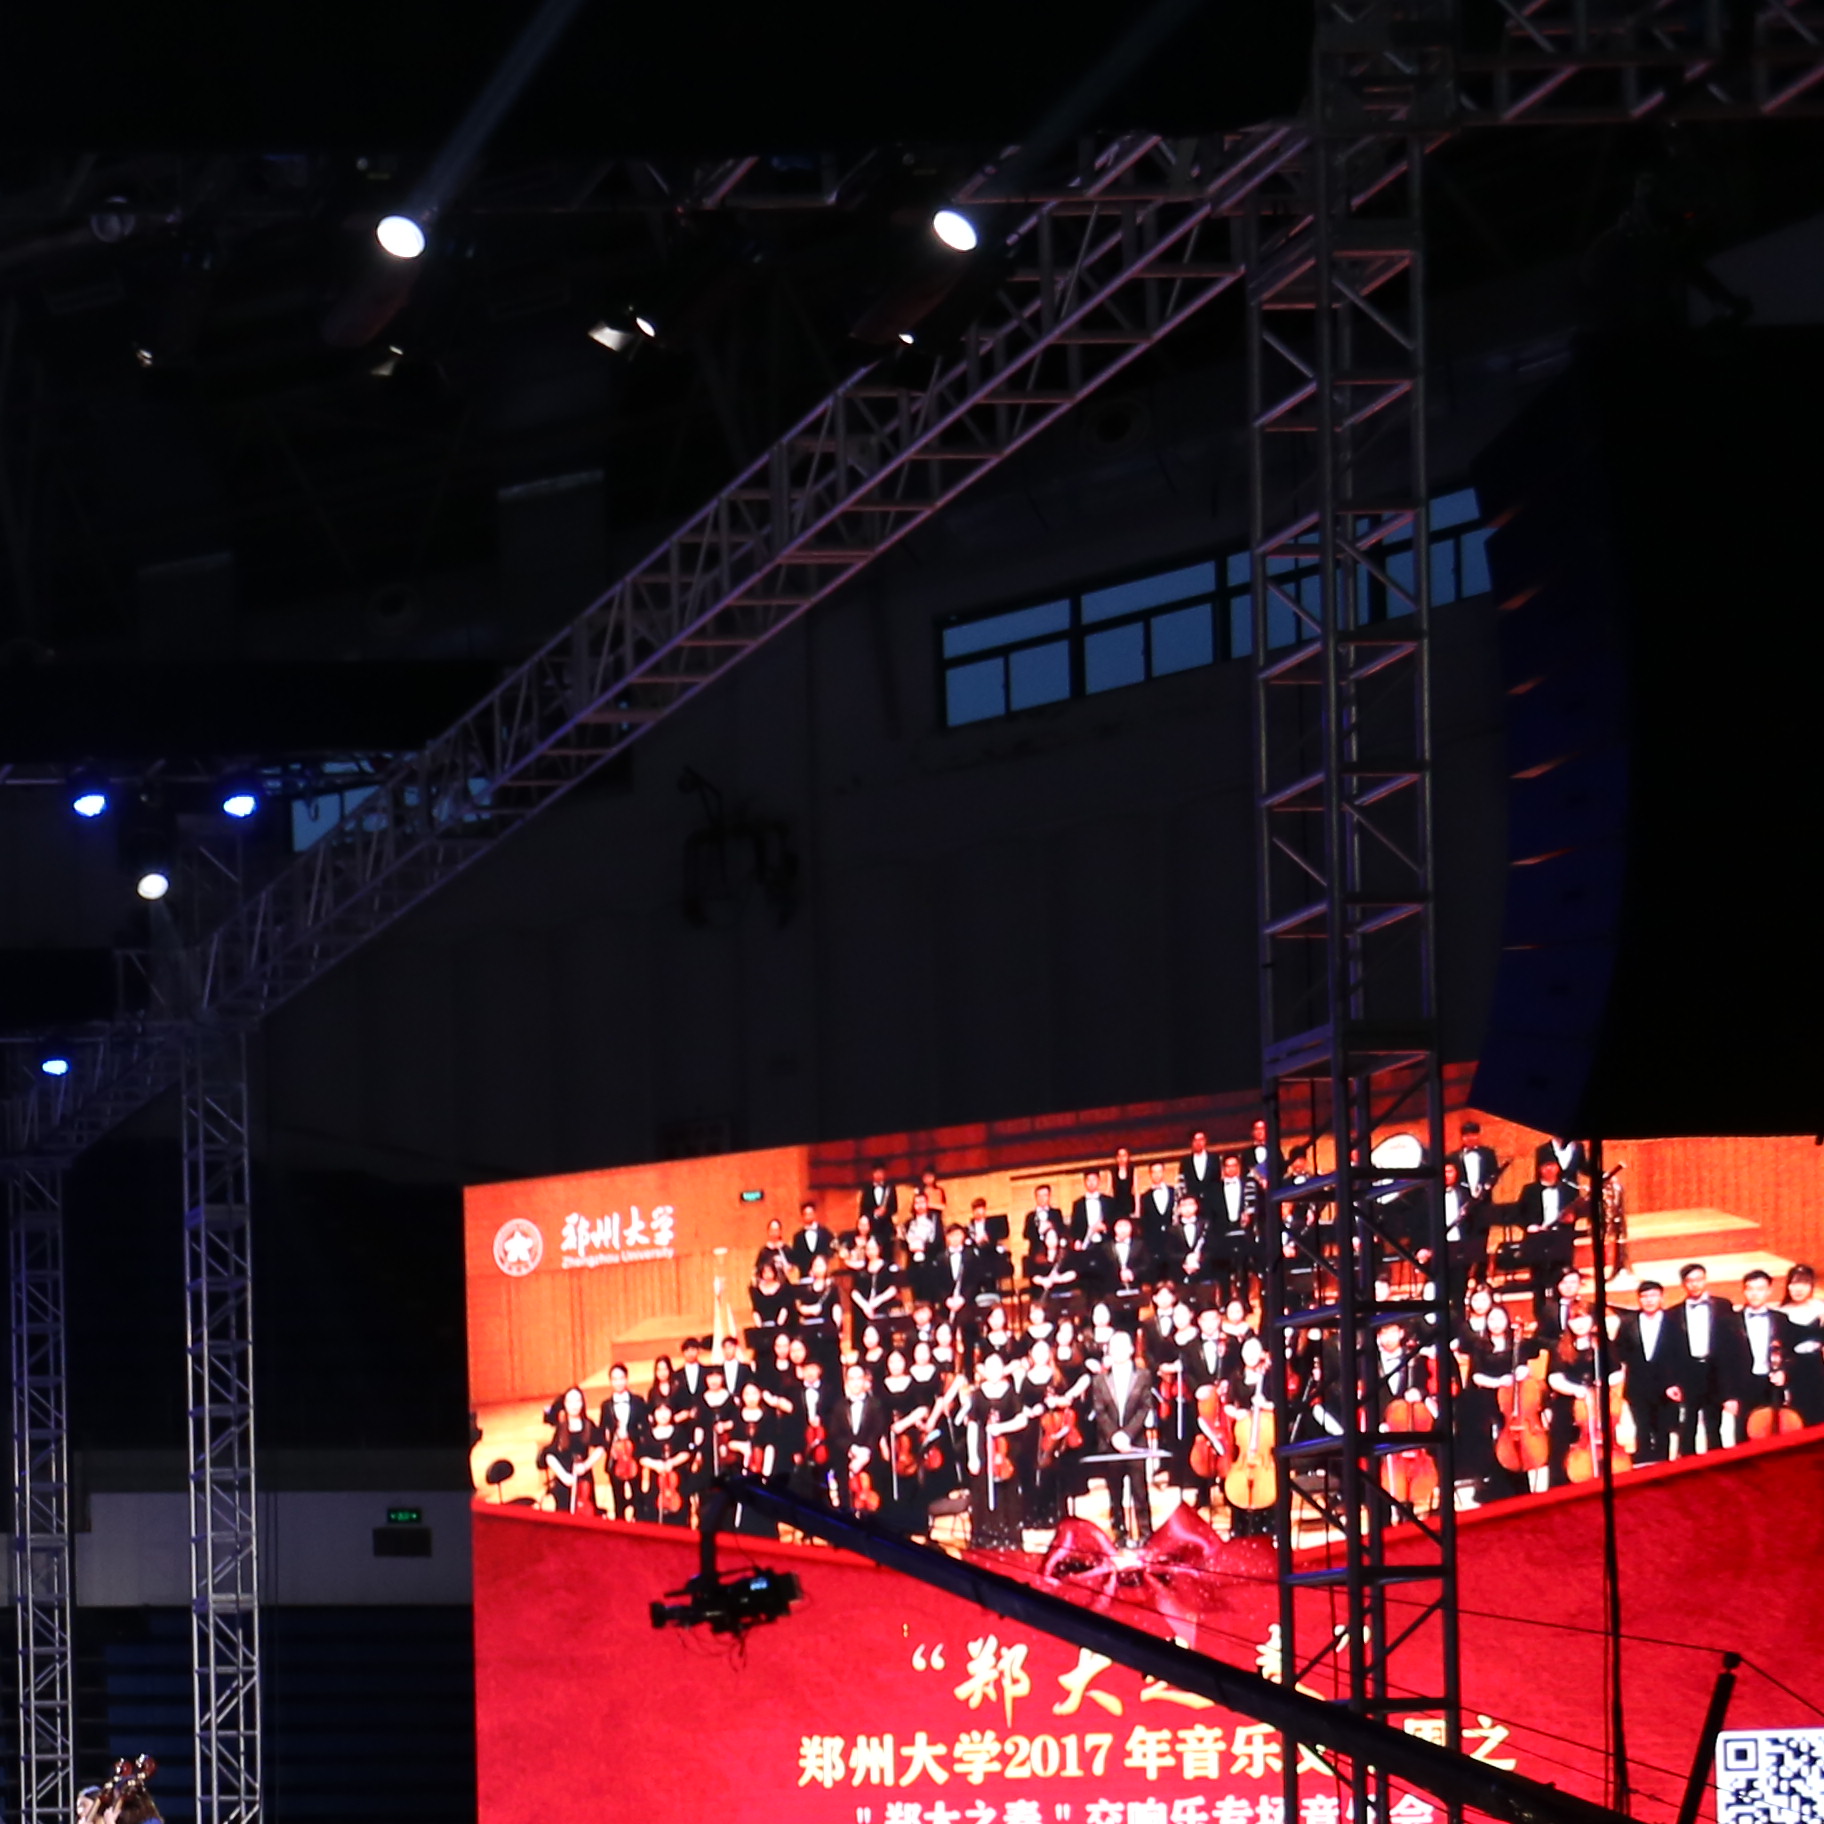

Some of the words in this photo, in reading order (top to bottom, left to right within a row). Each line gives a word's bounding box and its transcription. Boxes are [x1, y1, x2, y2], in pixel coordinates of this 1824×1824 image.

[560, 1205, 674, 1258] 郑州大学
[798, 1714, 1517, 1788] 郑州大学2017年音乐之
